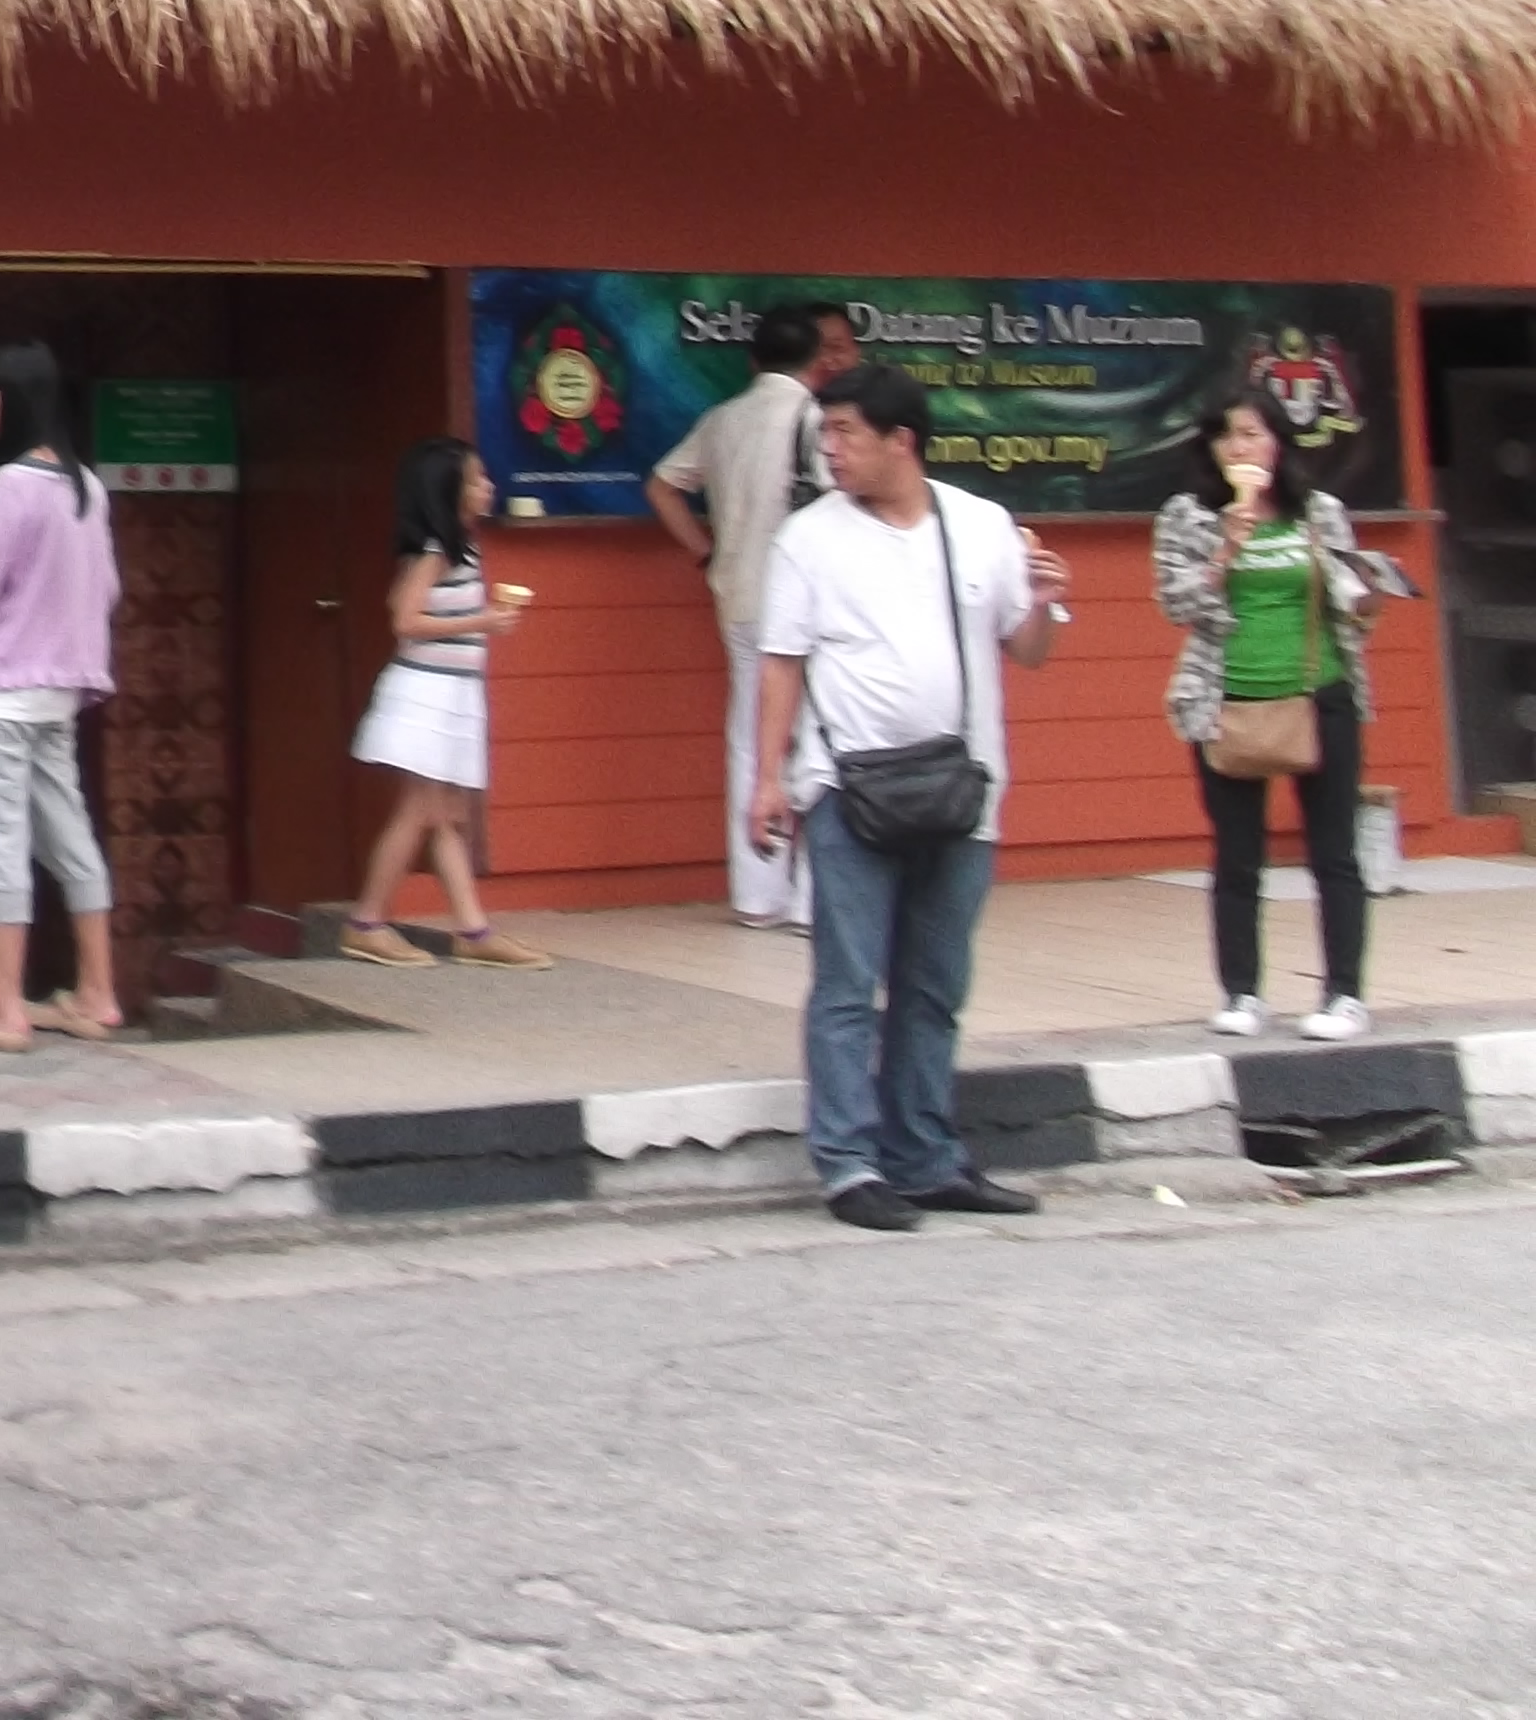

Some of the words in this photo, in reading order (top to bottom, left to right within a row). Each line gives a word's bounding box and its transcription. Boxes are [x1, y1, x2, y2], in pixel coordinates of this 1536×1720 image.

[680, 299, 763, 343] Sela
[845, 301, 986, 355] Datang
[989, 302, 1042, 345] ke
[1044, 303, 1205, 347] Muzium
[988, 359, 1097, 387] Museum
